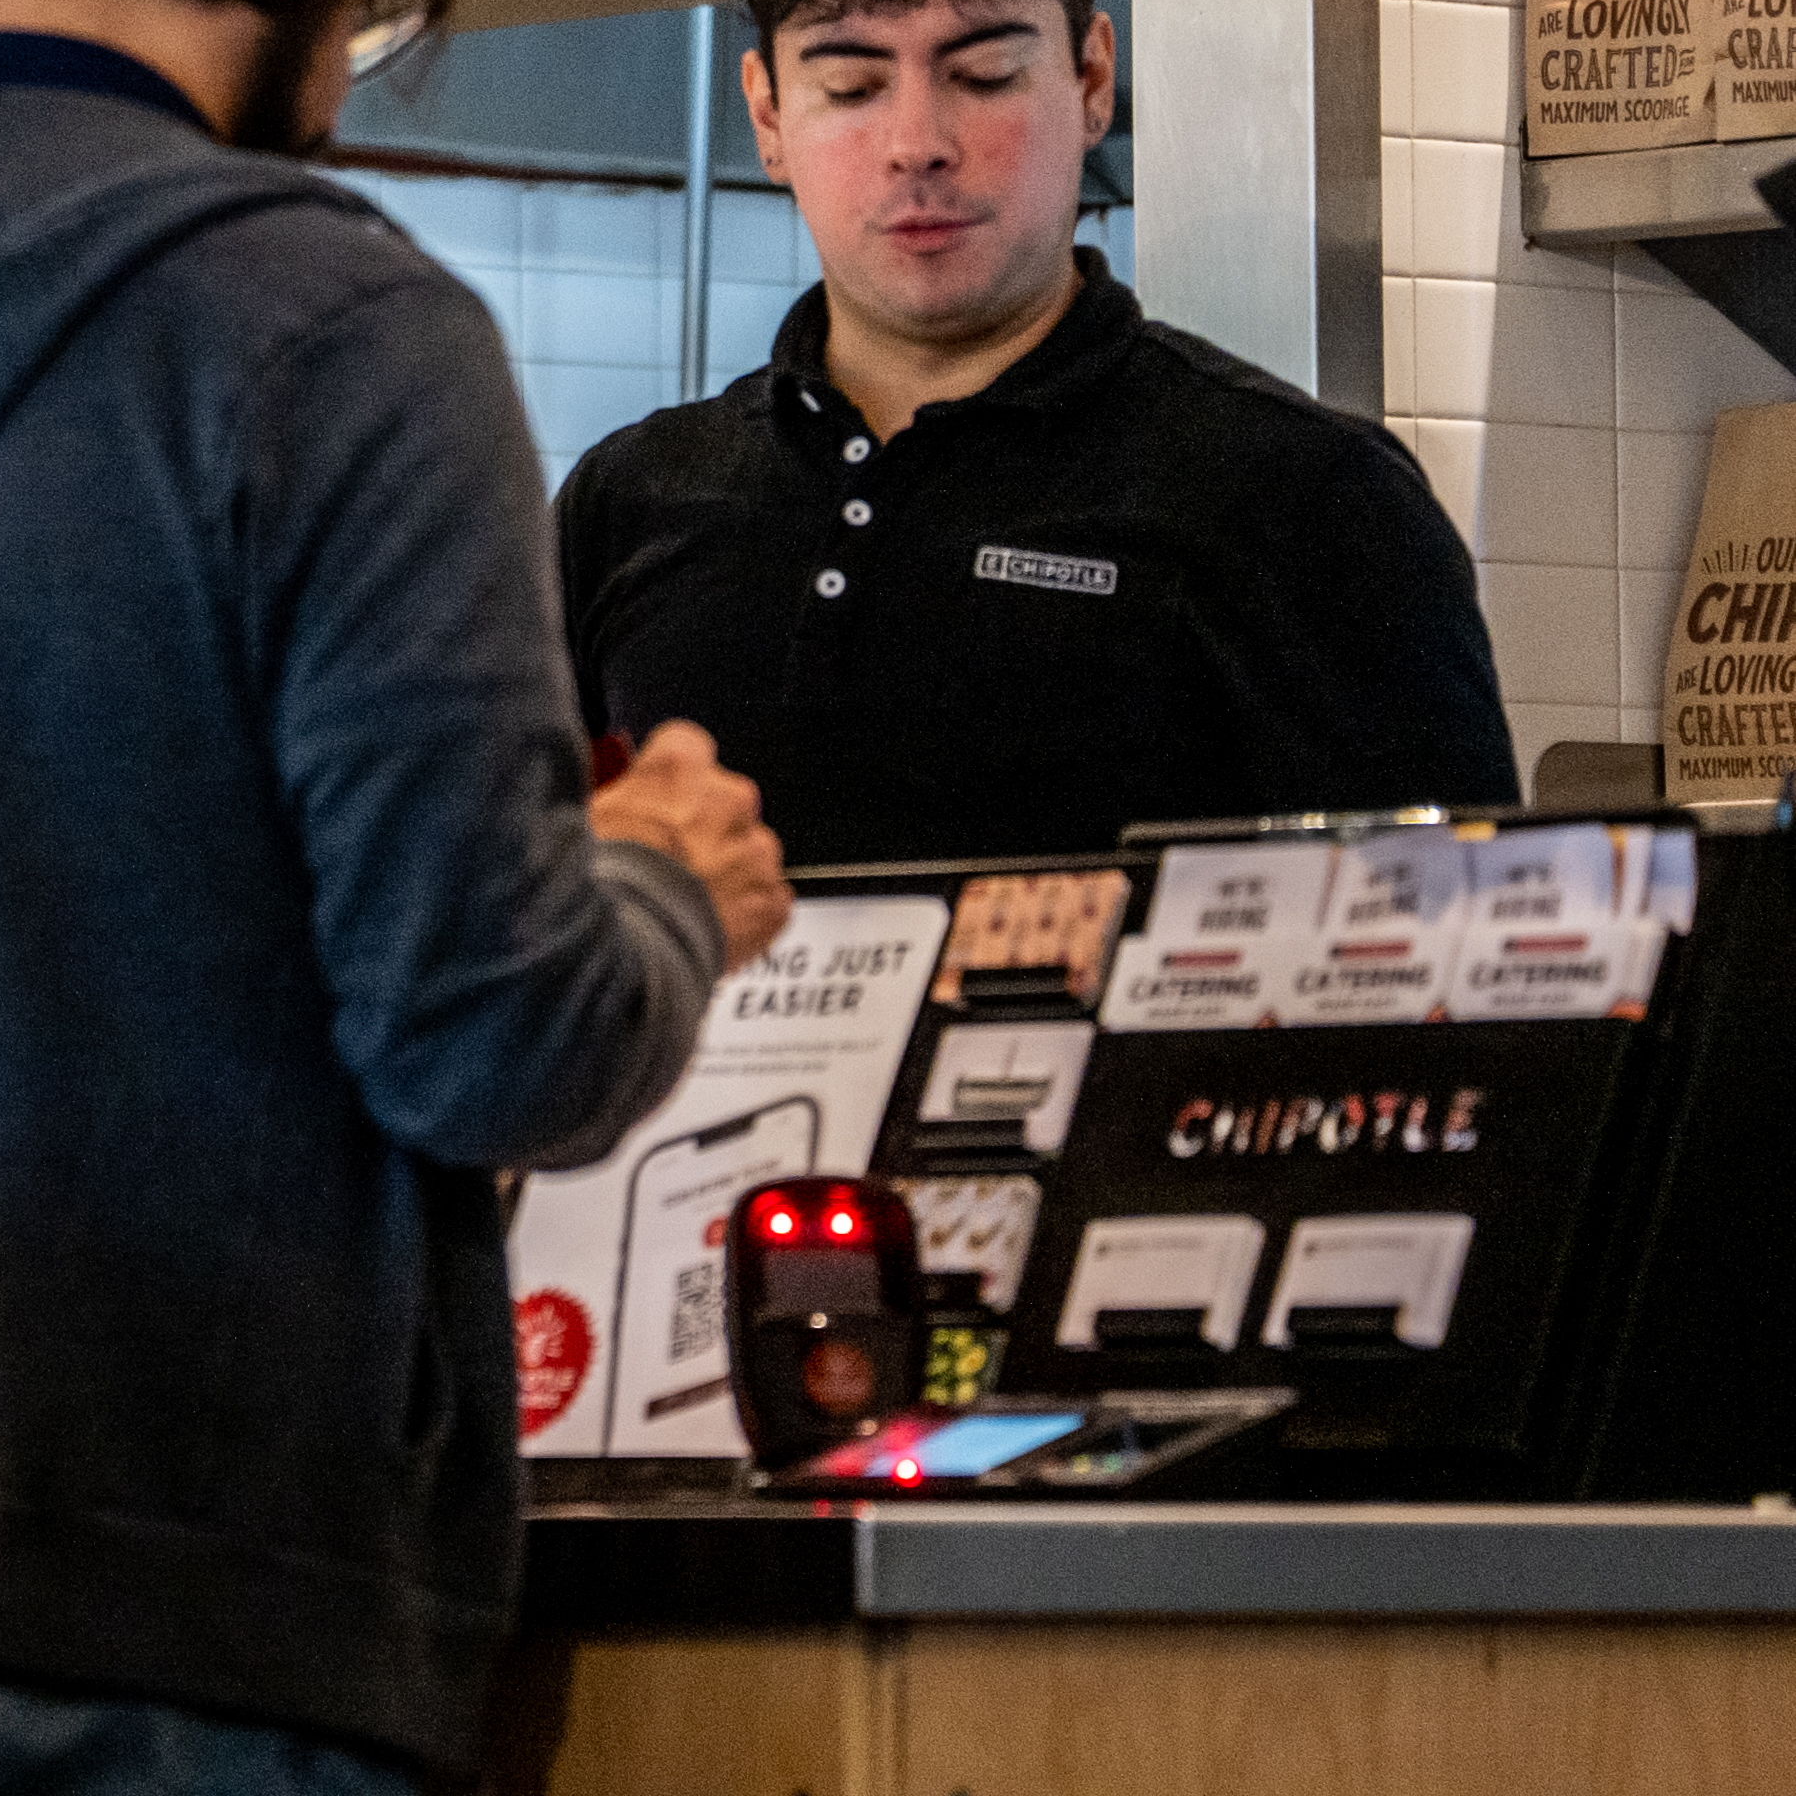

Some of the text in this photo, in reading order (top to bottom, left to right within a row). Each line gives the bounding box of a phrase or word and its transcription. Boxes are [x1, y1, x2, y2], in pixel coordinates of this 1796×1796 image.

[1538, 10, 1563, 38] ARE
[1541, 44, 1678, 92] CRAFTED
[1540, 95, 1689, 124] MAXIMUM SCOOPAGE
[1677, 666, 1697, 693] ARE
[1679, 757, 1753, 780] MAXIMUM
[822, 941, 913, 977] JUST
[1168, 1087, 1487, 1159] CHIPOTLE
